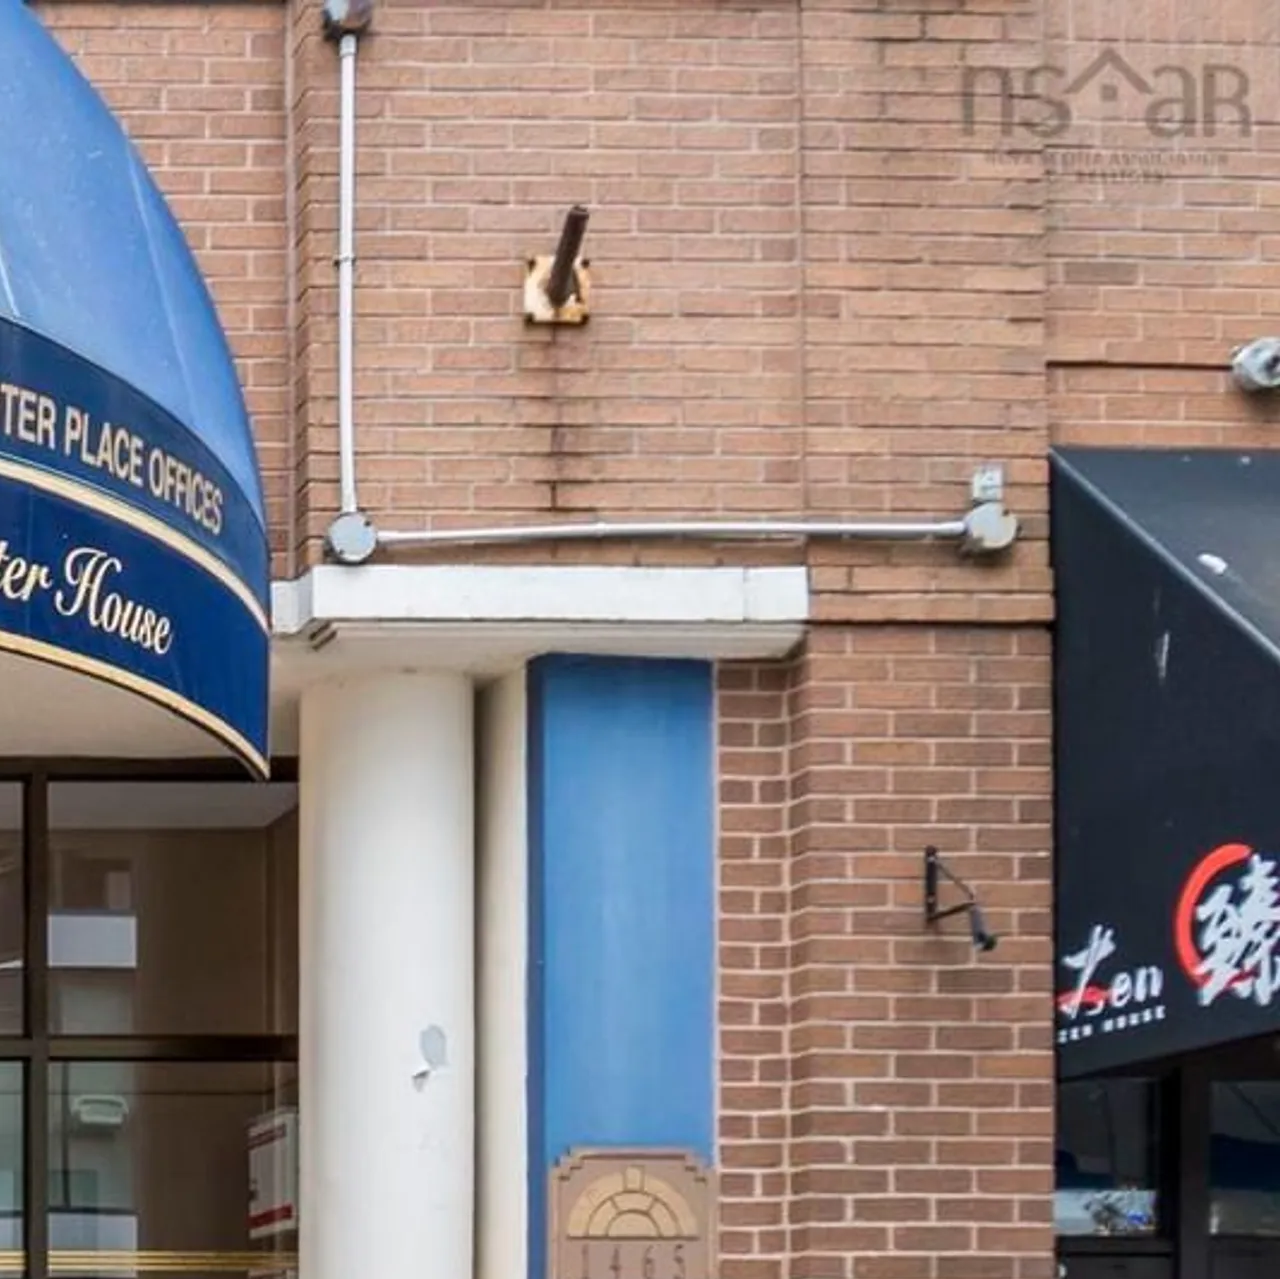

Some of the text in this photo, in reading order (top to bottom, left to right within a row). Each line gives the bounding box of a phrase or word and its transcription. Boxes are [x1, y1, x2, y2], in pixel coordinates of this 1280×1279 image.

[64, 405, 143, 484] PLACE
[148, 448, 222, 536] OFFICES
[54, 546, 172, 655] House
